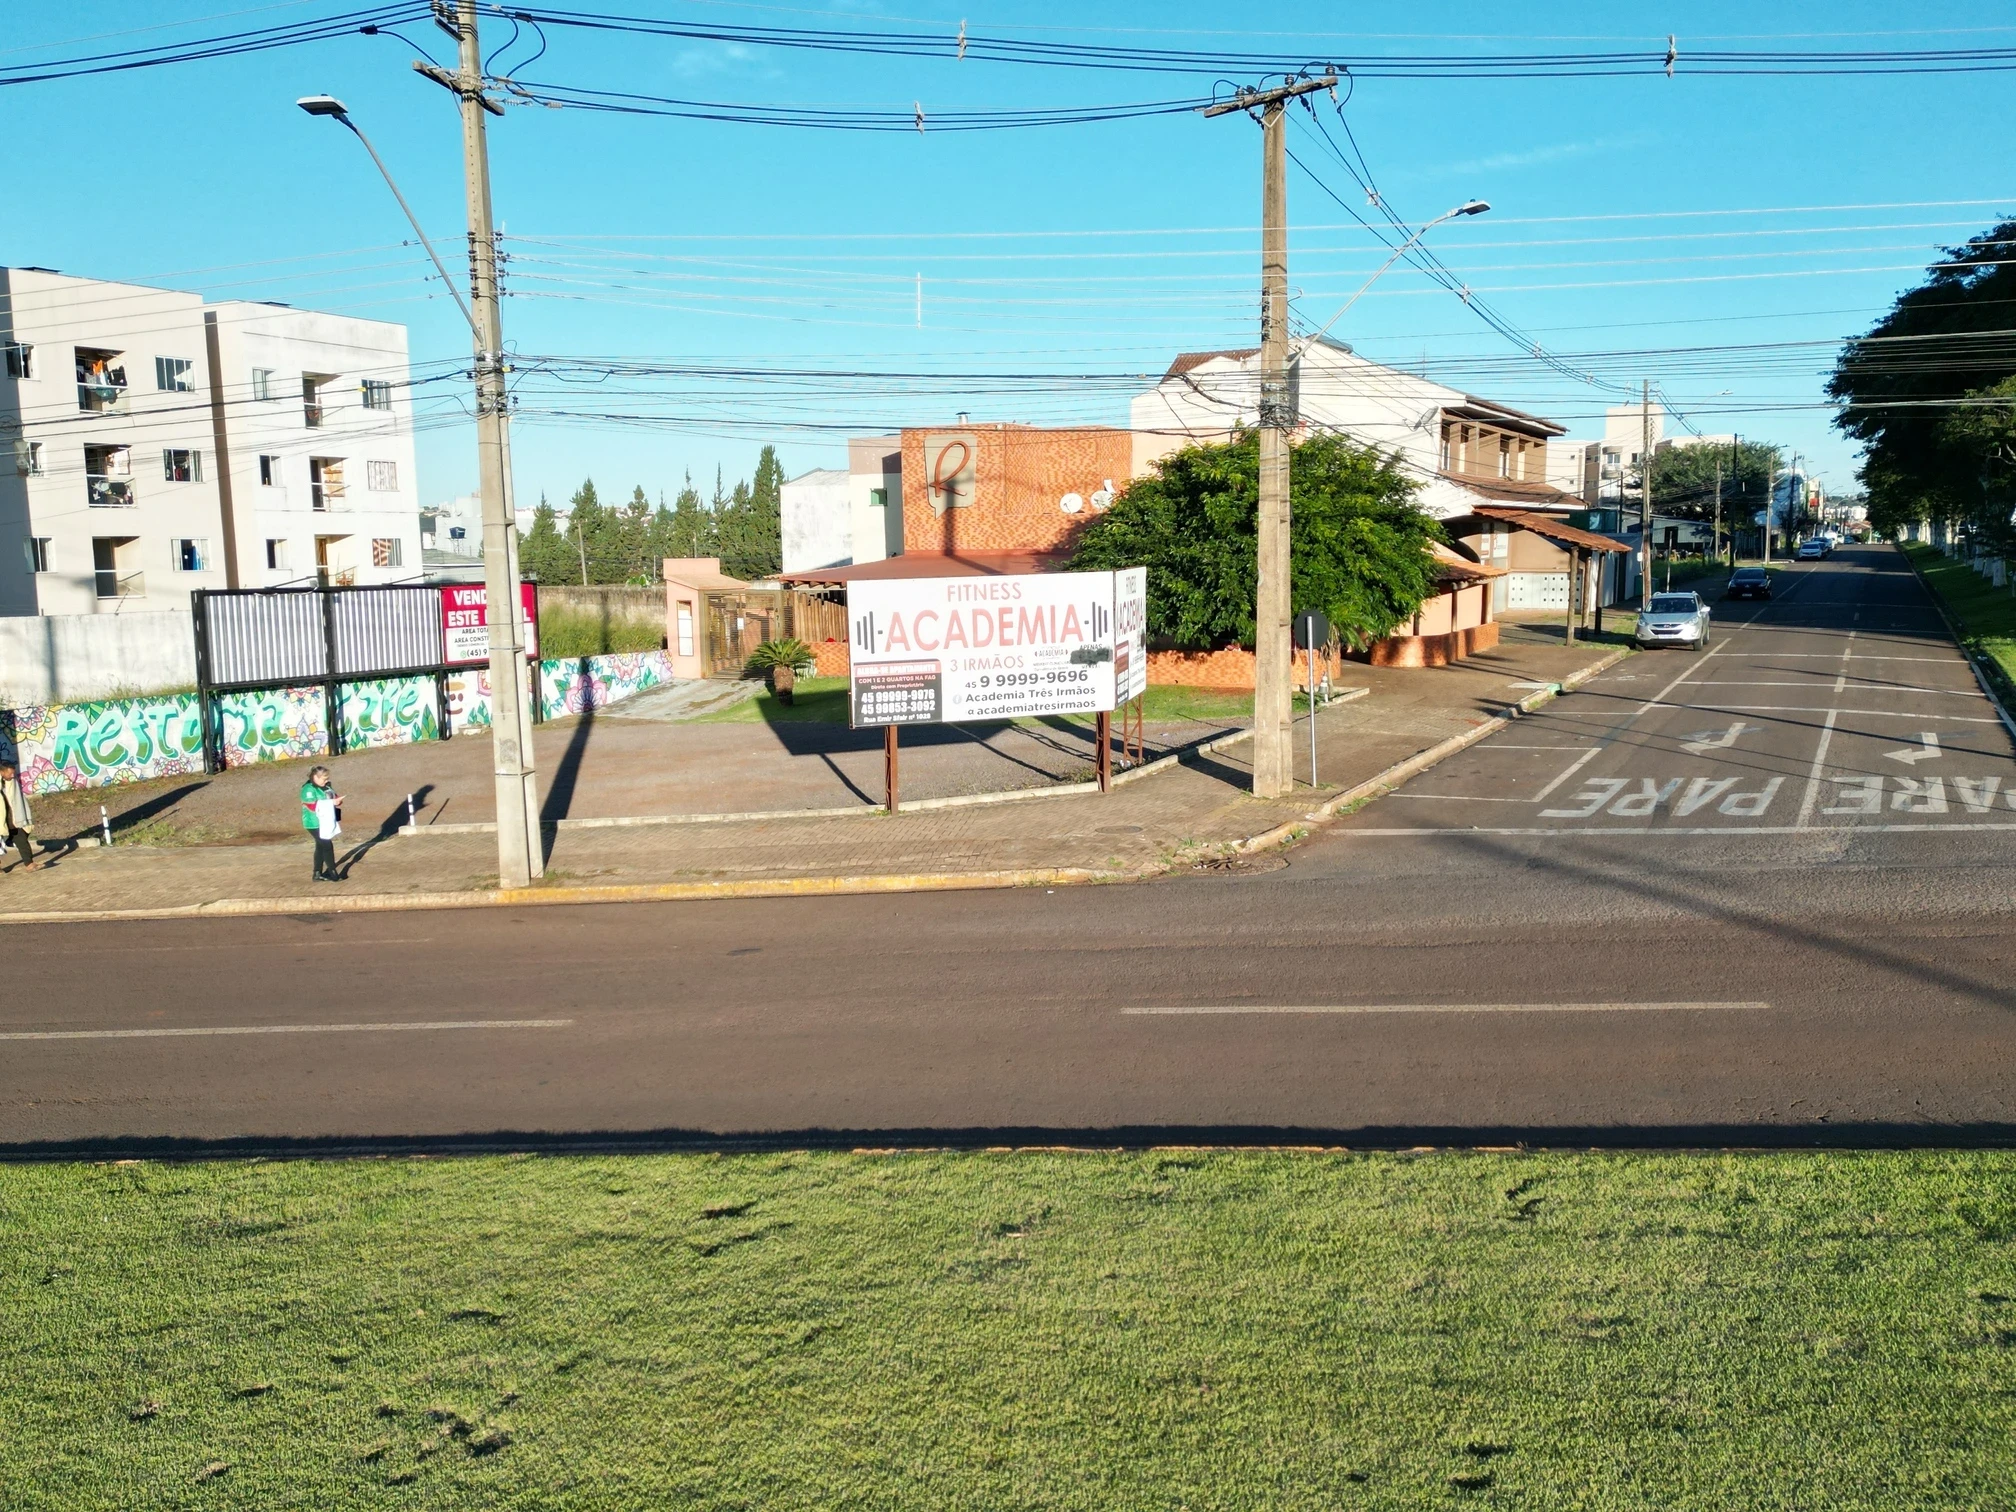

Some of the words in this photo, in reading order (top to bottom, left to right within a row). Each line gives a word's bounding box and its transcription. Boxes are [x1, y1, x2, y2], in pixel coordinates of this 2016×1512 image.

[453, 589, 487, 606] VEND
[948, 582, 1022, 602] FITNESS
[448, 610, 479, 626] ESTE
[885, 604, 1084, 652] ACADEMIA
[950, 659, 958, 671] 3
[964, 654, 1024, 670] IRMÃOS
[980, 675, 990, 688] 9
[996, 670, 1088, 686] 9999-9696
[861, 692, 874, 703] 45
[966, 690, 1024, 702] Academia
[1029, 688, 1053, 698] Três
[1057, 686, 1096, 696] Irmãos
[861, 704, 874, 714] 45
[1537, 777, 1786, 817] PARE
[1822, 776, 2016, 814] ARE
